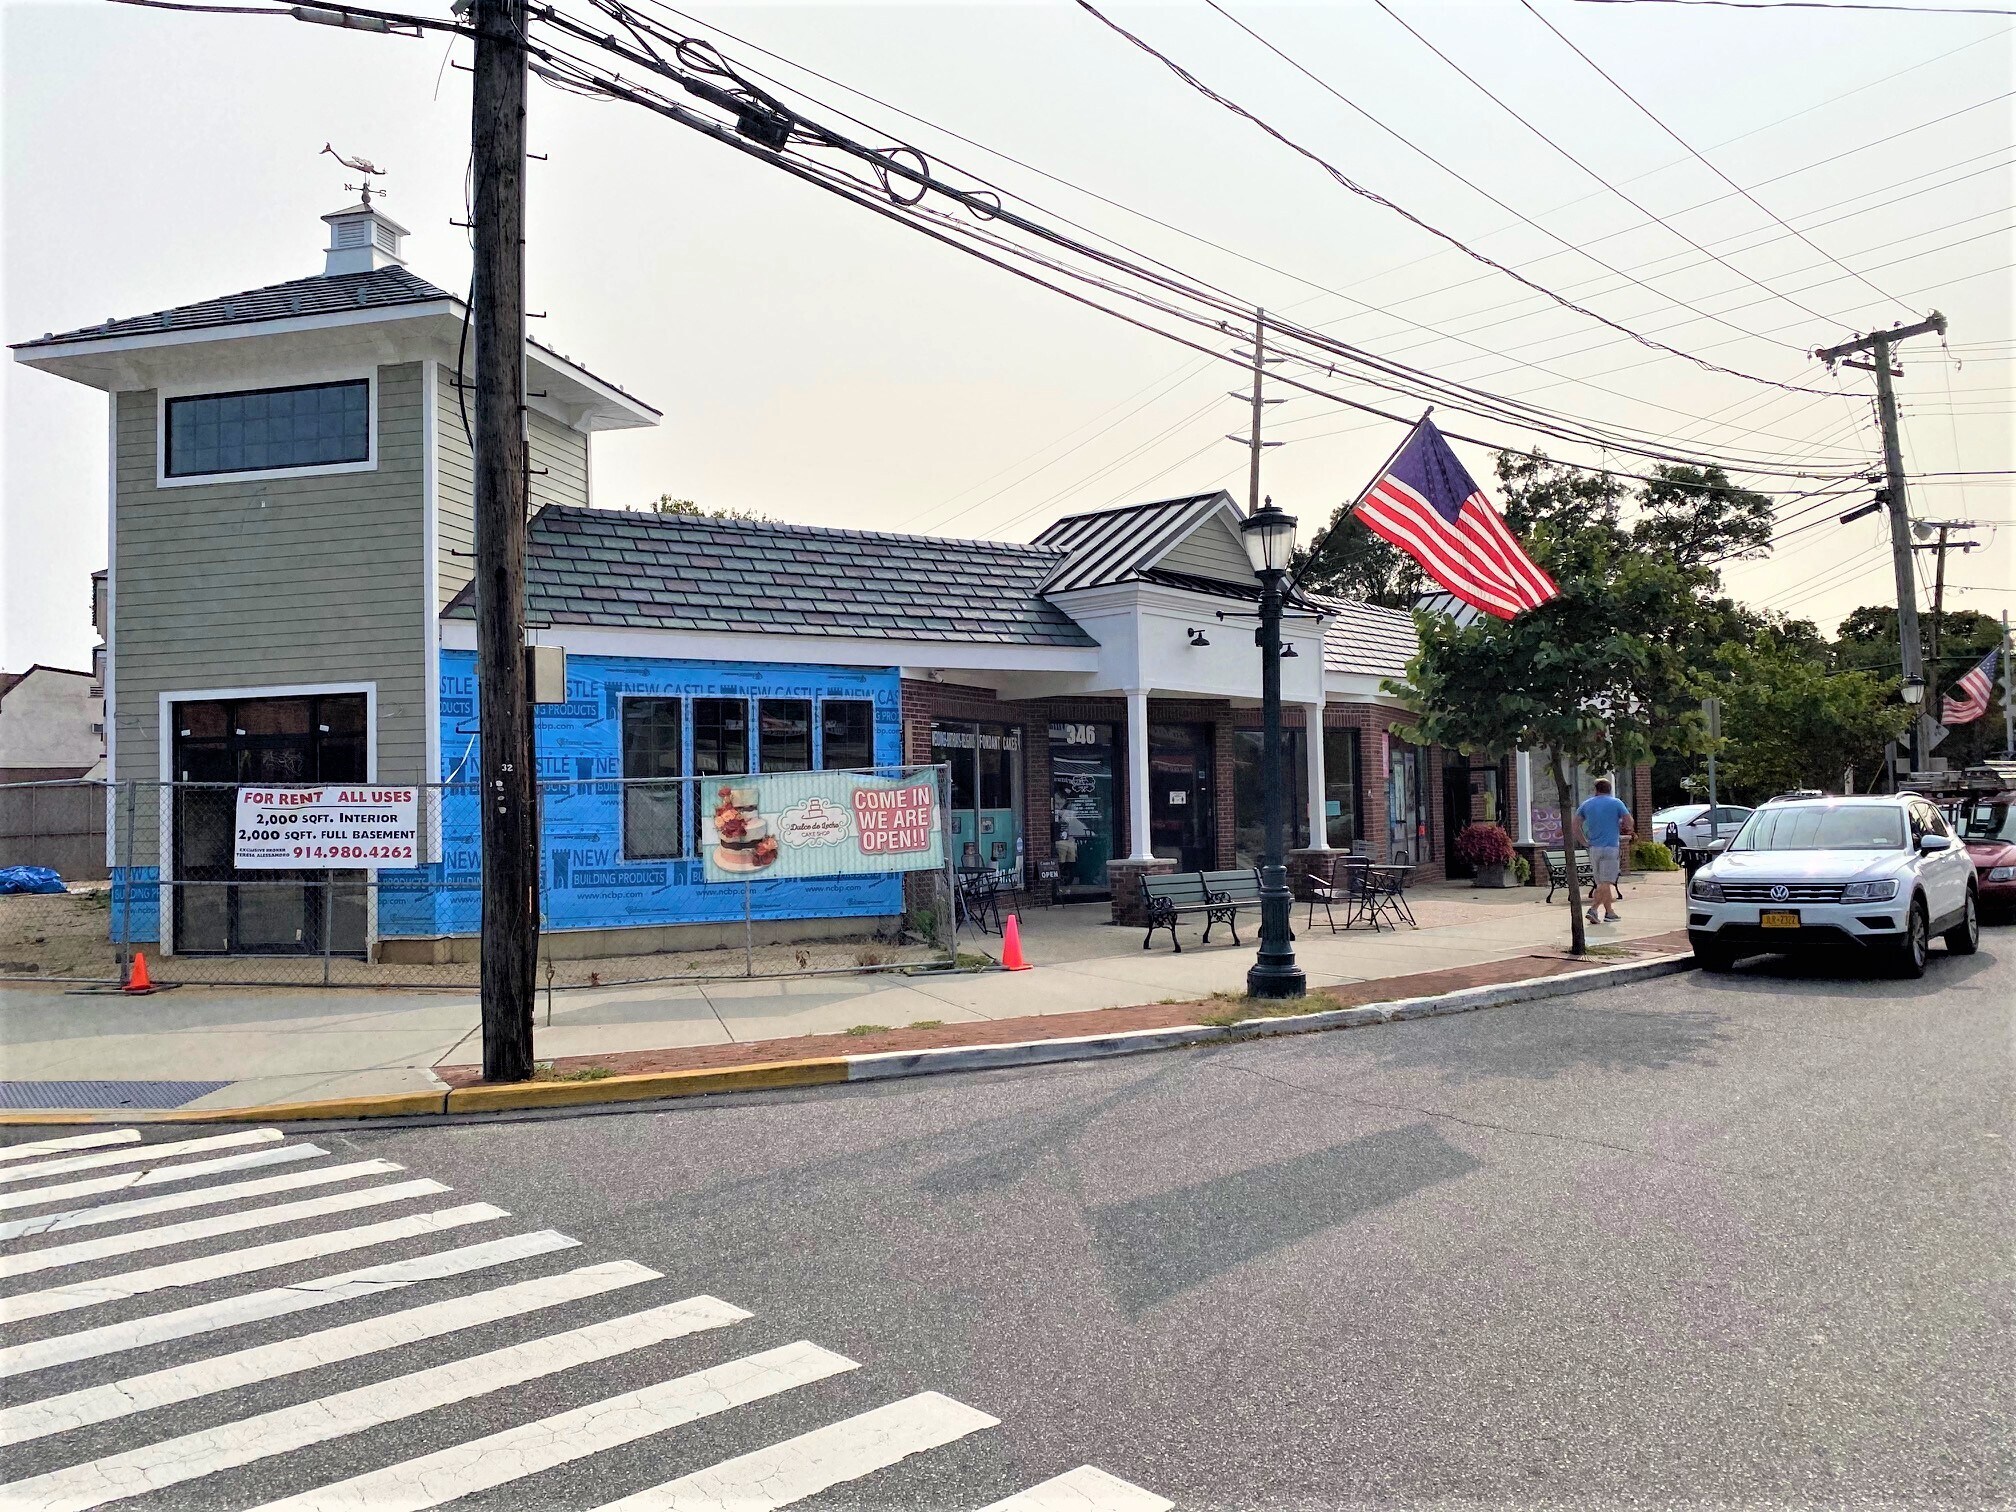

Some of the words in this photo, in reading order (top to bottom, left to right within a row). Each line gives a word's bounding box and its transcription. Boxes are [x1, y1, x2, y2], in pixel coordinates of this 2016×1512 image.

[344, 183, 352, 191] N
[379, 189, 387, 197] S
[549, 704, 597, 716] PRODUCTS
[1066, 725, 1095, 745] 346
[501, 764, 514, 772] 32
[243, 792, 275, 804] FOR
[278, 791, 323, 805] RENT
[338, 791, 367, 803] ALL
[371, 791, 412, 803] USES
[854, 789, 907, 810] COME
[912, 786, 930, 806] IN
[256, 814, 298, 825] 2,000
[302, 814, 334, 823] SQFT.
[858, 810, 888, 830] WE
[893, 808, 929, 829] ARE
[790, 822, 811, 831] Dulce
[812, 822, 821, 830] de
[821, 821, 840, 830] Leche
[238, 829, 280, 841] 2,000
[284, 831, 316, 840] SQFT.
[321, 830, 348, 840] FULL
[352, 830, 416, 840] BASEMENT
[862, 828, 926, 850] OPEN!!
[293, 846, 412, 859] 914.980.4262
[573, 849, 606, 867] NEW
[574, 873, 616, 885] BUILDING
[618, 871, 665, 884] PRODUCTS
[1041, 870, 1058, 878] OPEN
[805, 884, 861, 893] www.ncbp.com
[577, 890, 644, 901] www.ncbp.com
